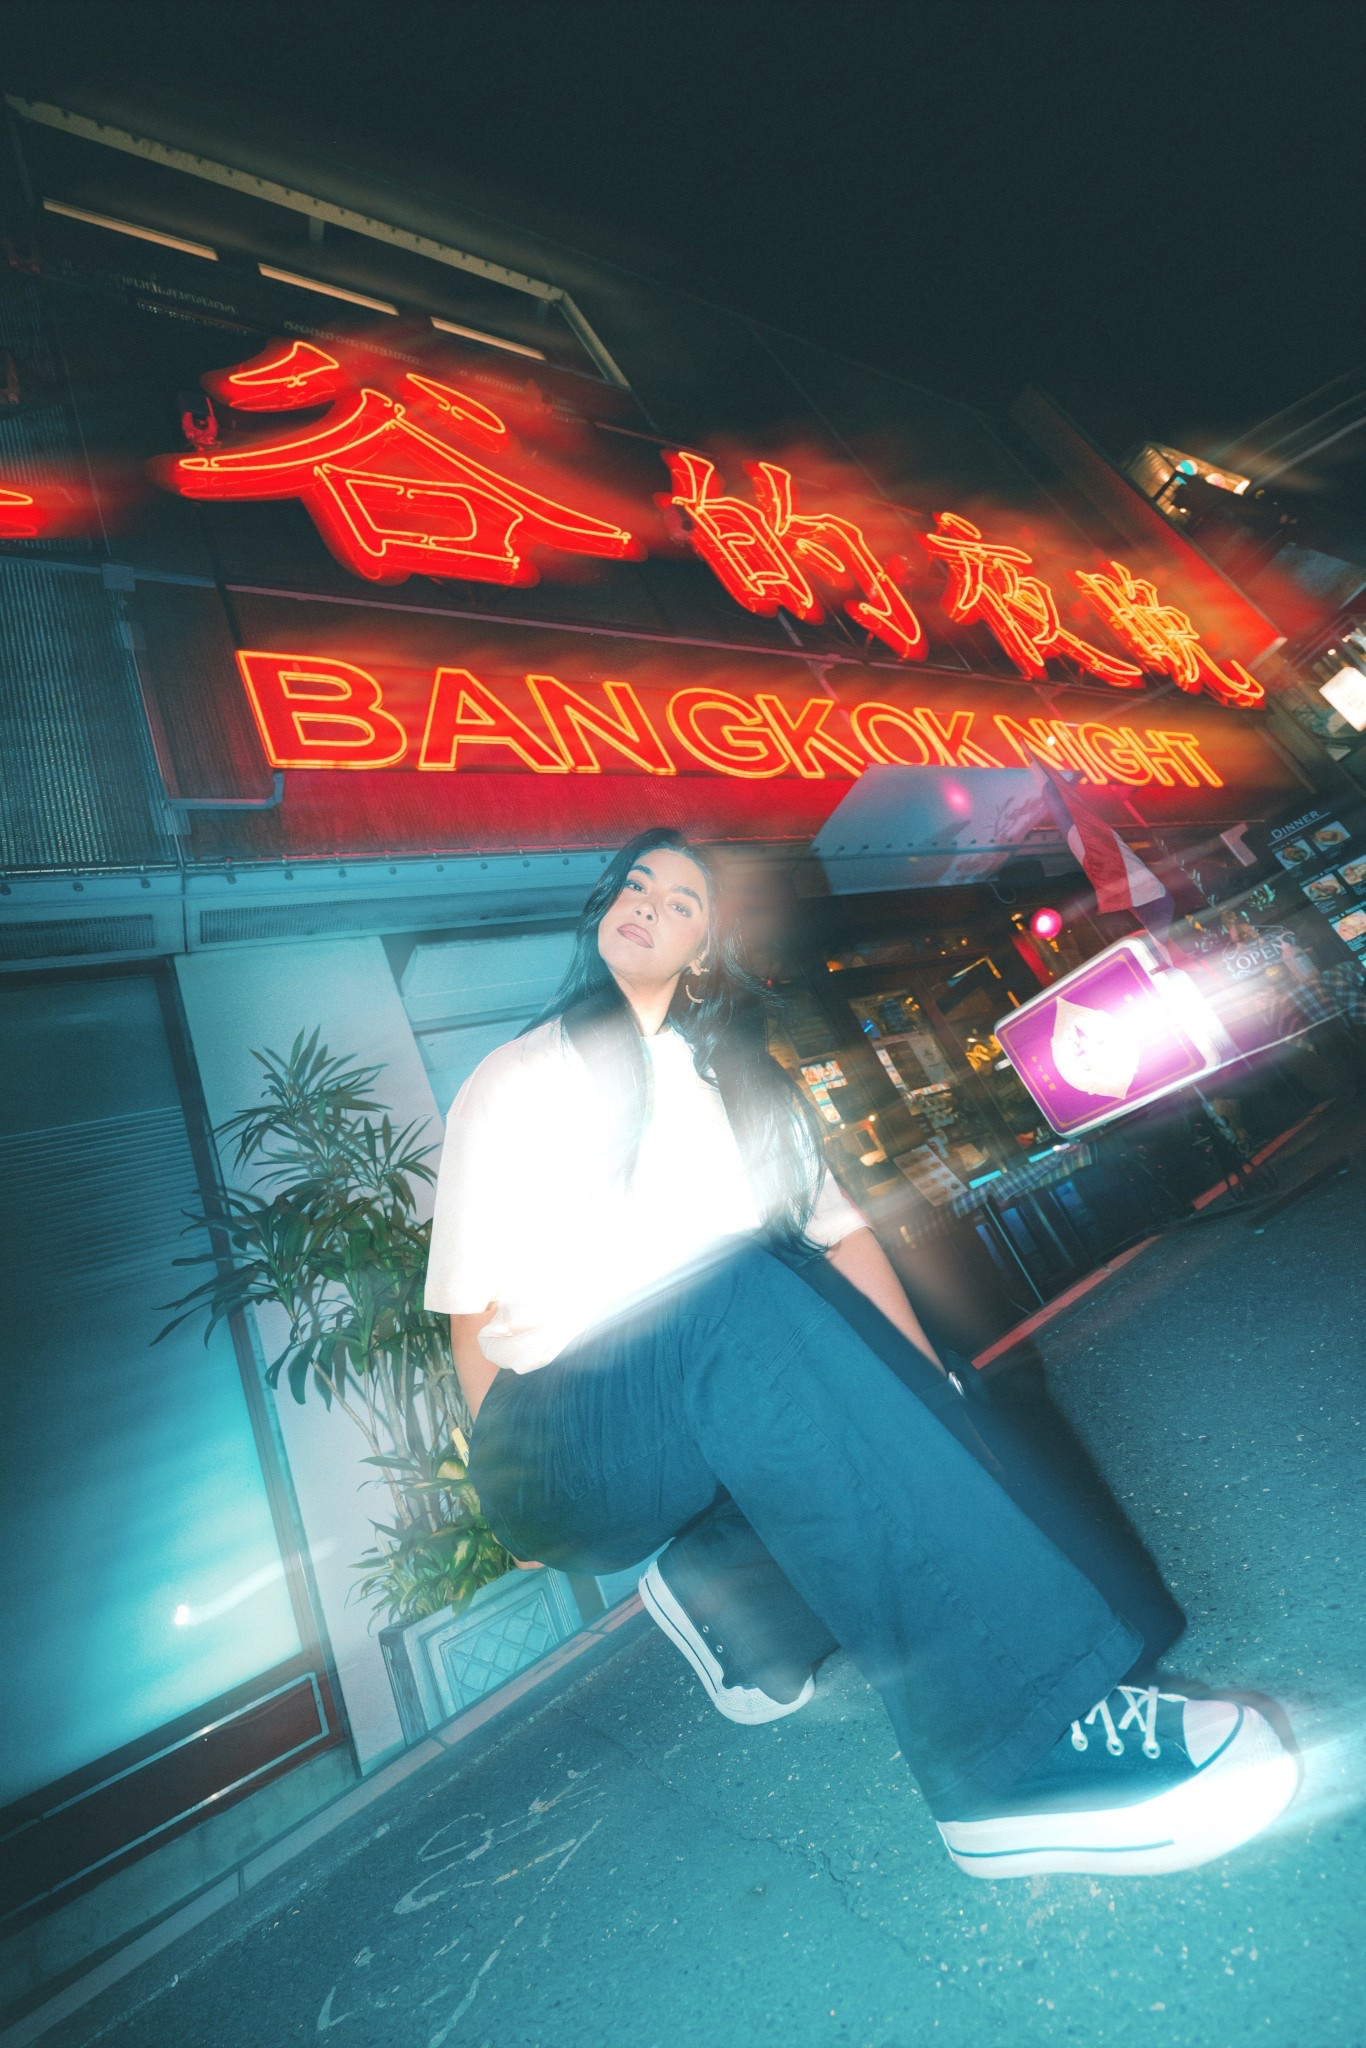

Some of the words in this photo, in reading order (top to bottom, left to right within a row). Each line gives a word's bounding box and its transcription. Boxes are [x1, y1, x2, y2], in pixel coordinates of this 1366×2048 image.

[0, 340, 1265, 708] 谷的夜晚
[236, 649, 1005, 779] BANGKOK
[993, 713, 1225, 788] NIGHT
[1270, 809, 1320, 840] DINNER
